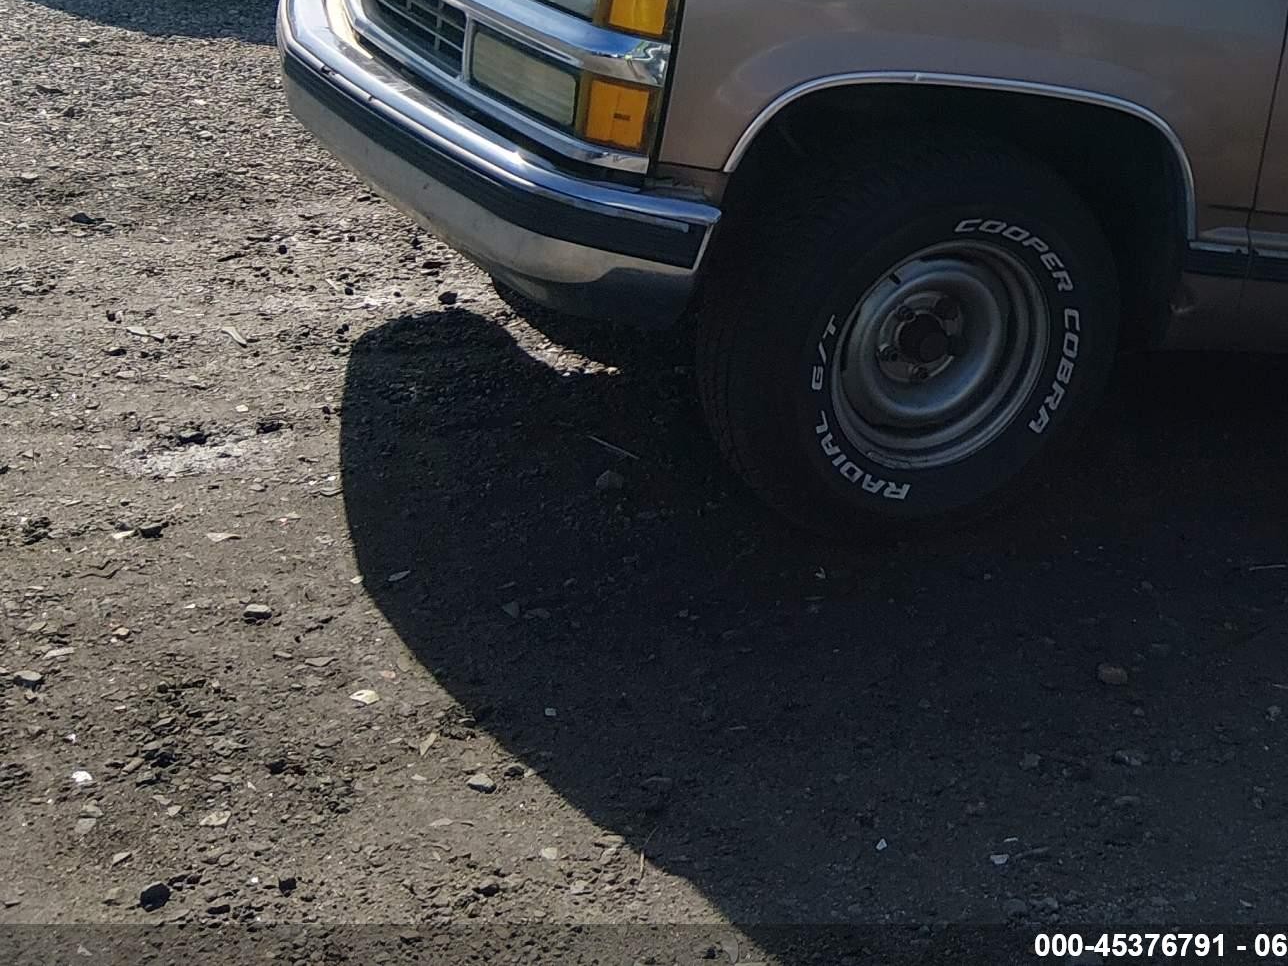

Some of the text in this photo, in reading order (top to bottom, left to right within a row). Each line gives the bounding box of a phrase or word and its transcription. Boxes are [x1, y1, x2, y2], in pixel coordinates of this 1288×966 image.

[955, 219, 1081, 433] COOPER COBRA
[816, 410, 911, 500] RADIAL
